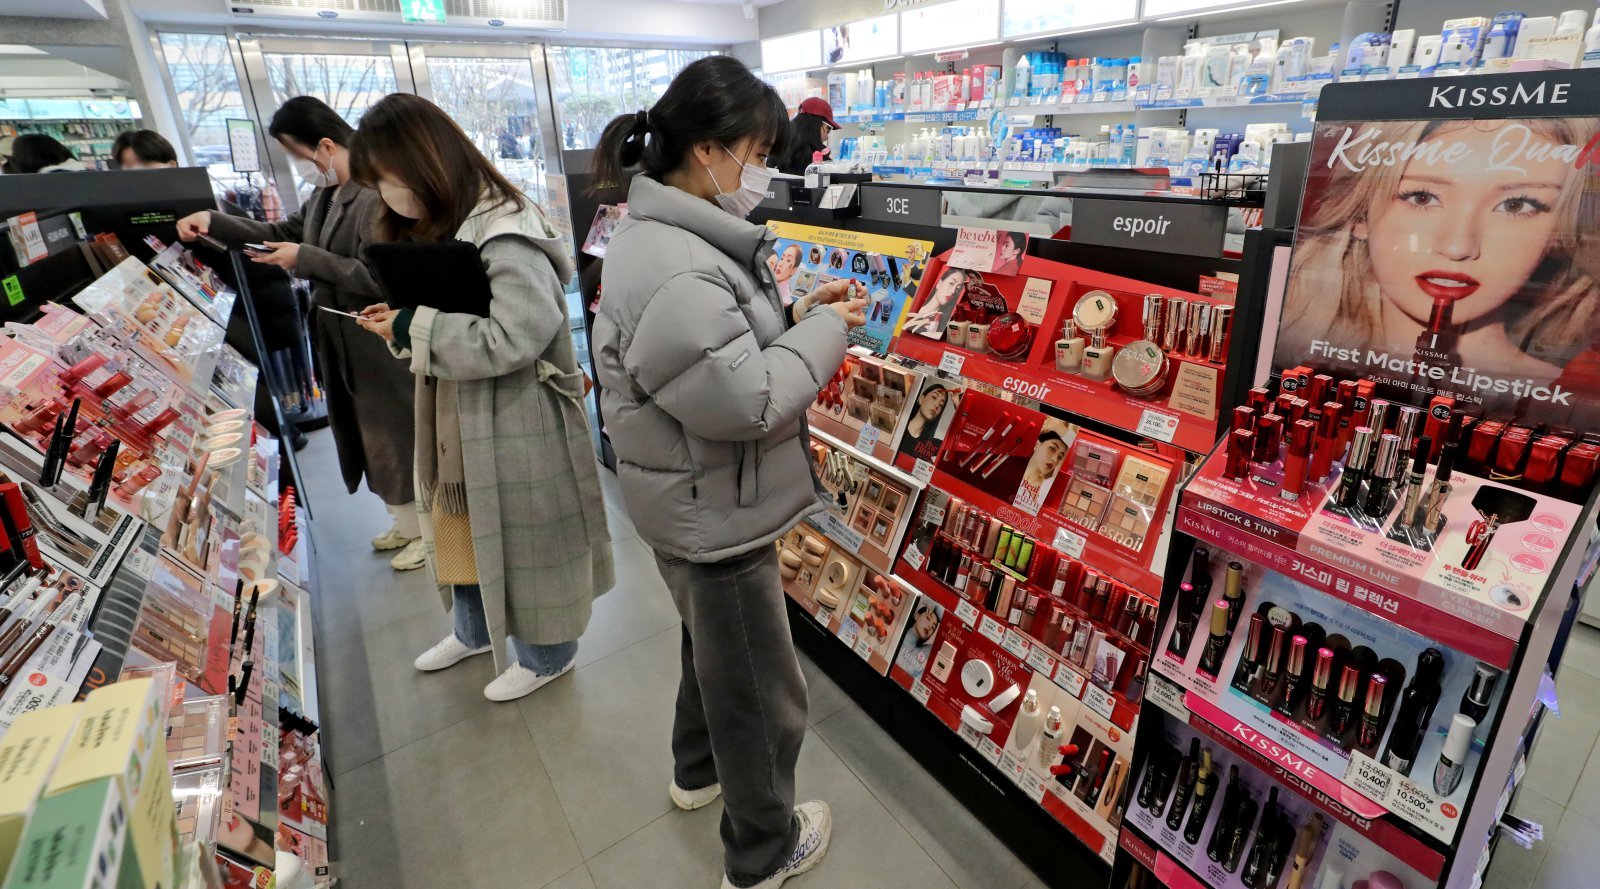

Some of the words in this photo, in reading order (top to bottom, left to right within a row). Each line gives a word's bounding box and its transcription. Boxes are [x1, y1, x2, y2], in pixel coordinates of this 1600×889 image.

[1429, 80, 1571, 108] KISSME
[1328, 126, 1476, 174] Kissme
[886, 197, 910, 215] 3CE
[1113, 215, 1171, 238] espoir
[1414, 347, 1449, 360] KISSME
[1309, 339, 1360, 364] First
[1365, 352, 1445, 381] Matte
[1450, 364, 1574, 407] Lipstick
[1003, 375, 1052, 401] espoir
[1368, 374, 1391, 386] 키스미
[1410, 383, 1435, 395] 퍼스트
[1456, 392, 1483, 406] 립스틱
[1432, 406, 1450, 418] 증정
[1020, 479, 1041, 493] Real
[996, 505, 1042, 536] espoir
[1197, 501, 1242, 525] LIPSTICK
[1243, 519, 1251, 528] &
[1254, 522, 1280, 538] TINT
[1256, 496, 1271, 506] First
[1270, 500, 1280, 510] Lip
[1280, 504, 1308, 519] Collection
[1183, 517, 1221, 539] KISSME
[1227, 535, 1247, 549] 키스미
[1291, 559, 1331, 586] 키스미
[1335, 577, 1350, 594] 립
[1353, 584, 1400, 615] 컬렉션
[1309, 544, 1367, 572] PREMIUM
[1368, 567, 1400, 585] LINE
[1440, 591, 1501, 621] EYELASH
[1441, 600, 1496, 627] CURLER
[1286, 719, 1301, 731] LONG
[1233, 722, 1317, 779] KISSME
[1275, 765, 1313, 796] 키스미
[1358, 768, 1386, 789] 10,400
[1396, 788, 1426, 810] 10,500
[1441, 805, 1456, 816] SALE
[1125, 837, 1155, 866] KISSME
[257, 868, 272, 889] NEW
